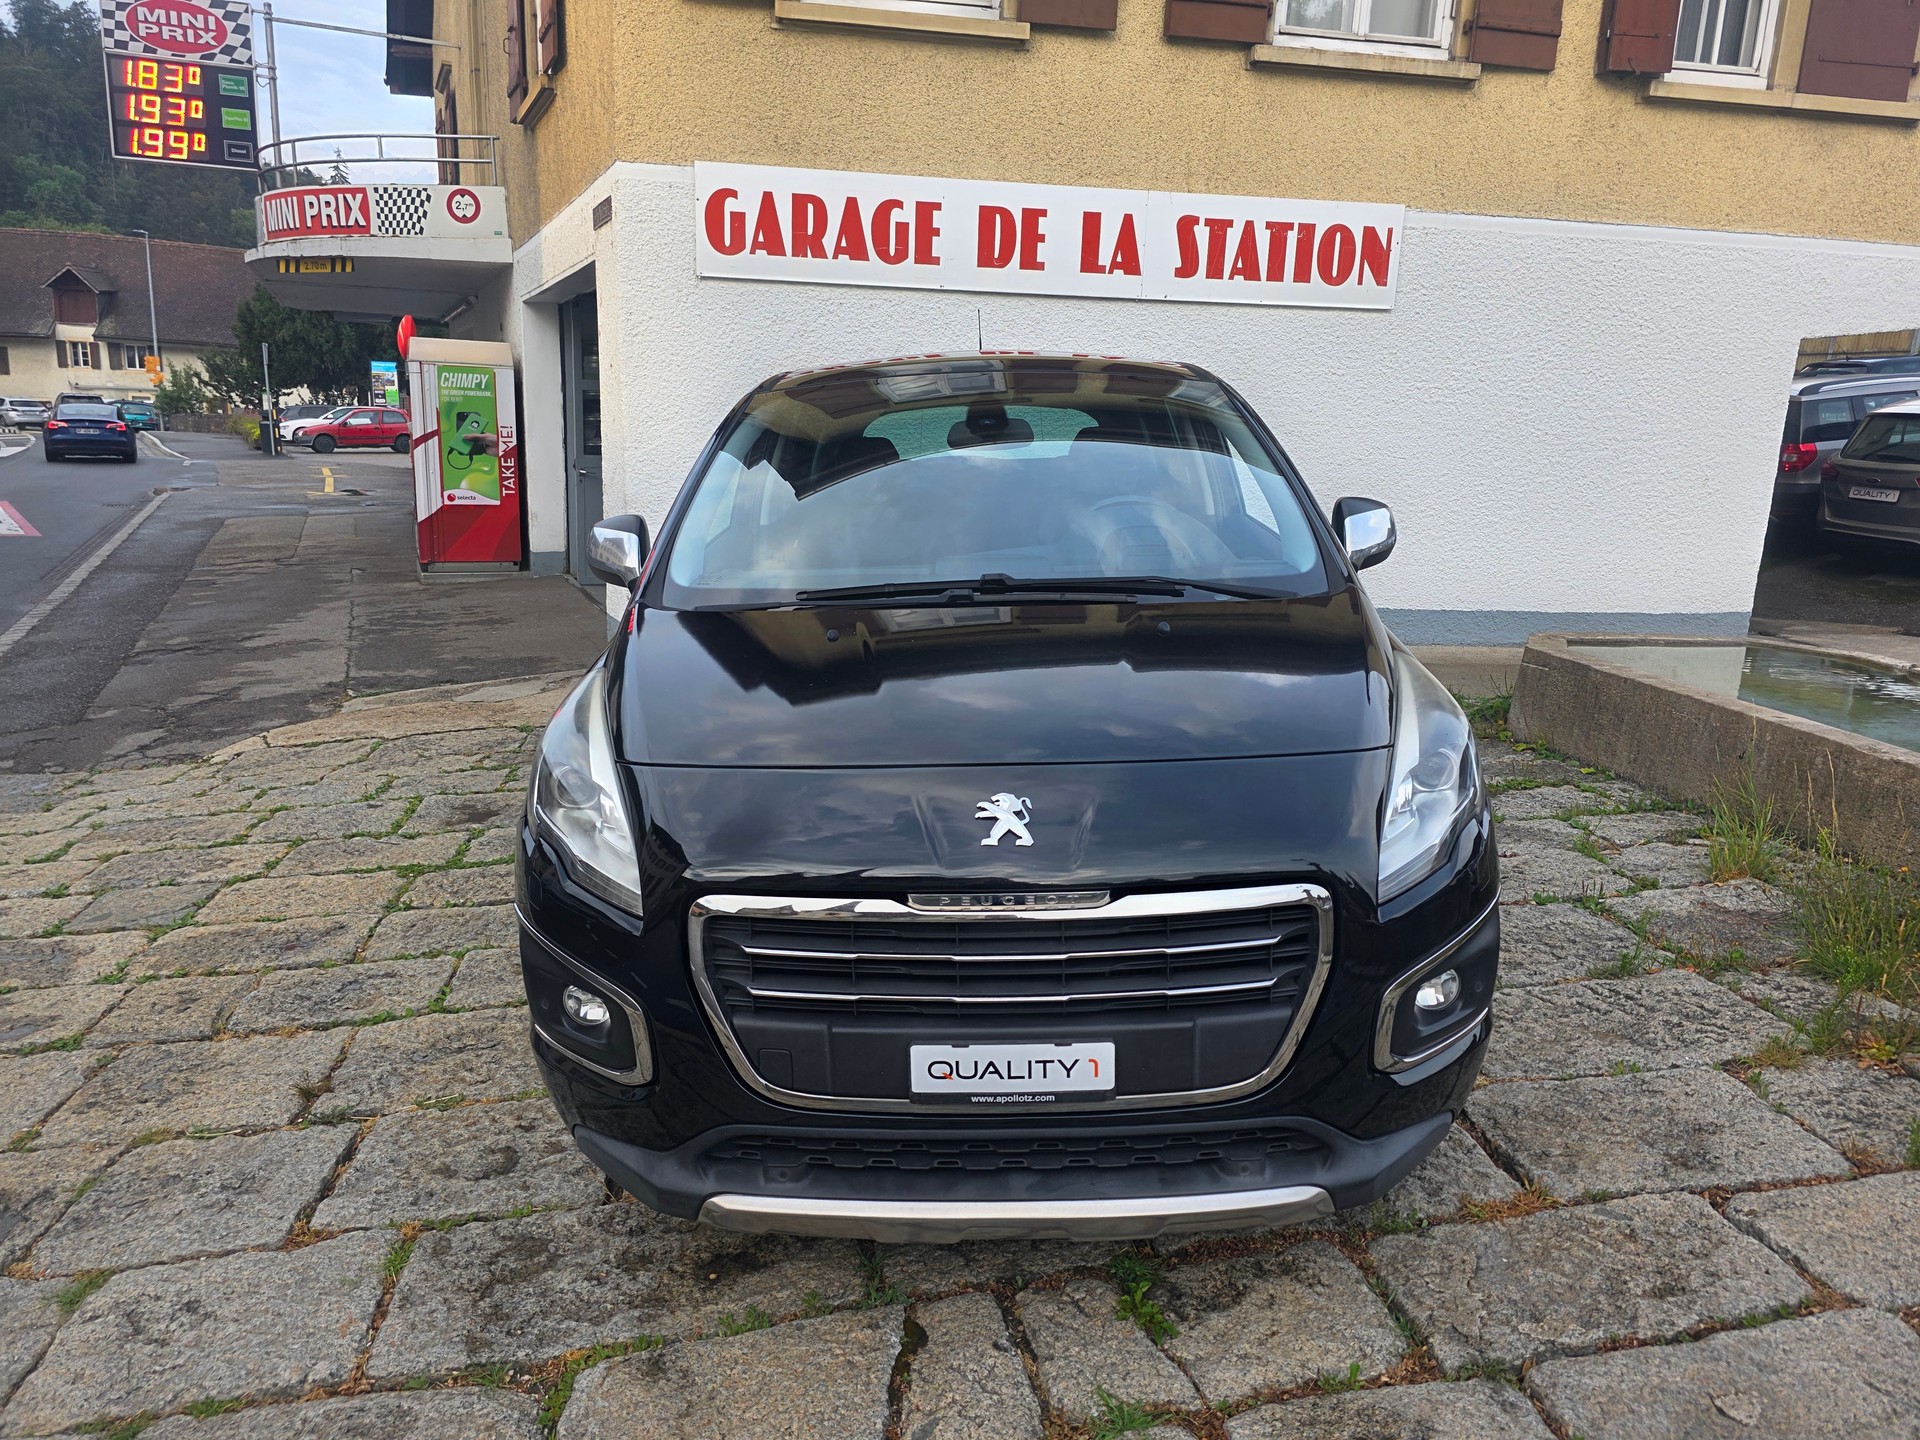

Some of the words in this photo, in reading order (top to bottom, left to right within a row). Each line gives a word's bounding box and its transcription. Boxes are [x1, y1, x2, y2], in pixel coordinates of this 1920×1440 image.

[136, 6, 217, 30] MINI
[137, 23, 218, 46] PRIX
[266, 196, 300, 232] MINI
[304, 193, 367, 228] PRIX
[704, 187, 942, 266] GARAGE
[976, 205, 1048, 271] DE
[1080, 211, 1142, 277] LA
[1174, 214, 1394, 288] STATION
[440, 372, 489, 389] CHIMPY
[500, 425, 514, 456] ME!
[501, 457, 516, 496] TAKE
[1852, 489, 1891, 499] QUALITY
[939, 895, 1080, 906] PEUGEOT
[927, 1059, 1081, 1081] QUALITY
[1088, 1058, 1099, 1078] 1
[971, 1094, 1056, 1104] www.apollotz.com
